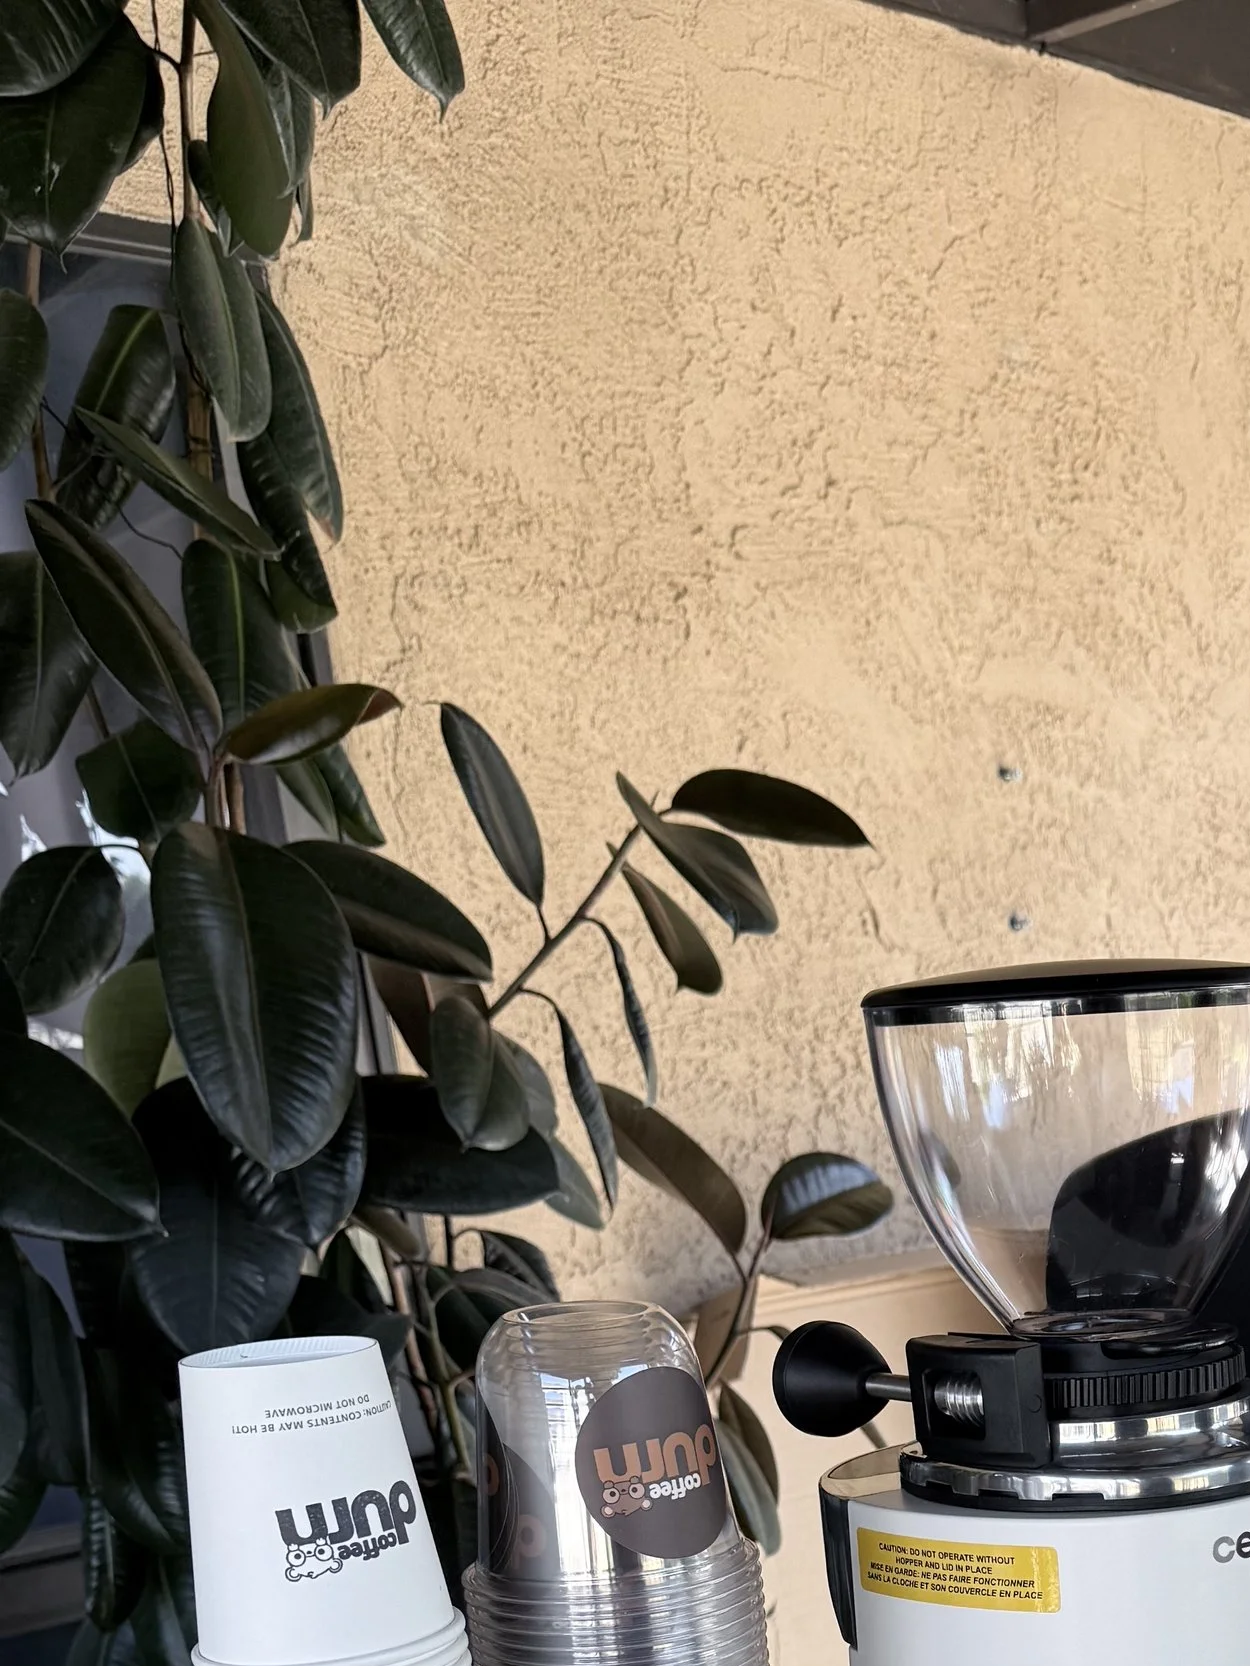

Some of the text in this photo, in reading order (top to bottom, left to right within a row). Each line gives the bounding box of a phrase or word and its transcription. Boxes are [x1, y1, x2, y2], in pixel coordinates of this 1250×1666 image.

[232, 1400, 392, 1434] CAUTION: CONTENTS MAY BE HOT!
[265, 1394, 370, 1418] DO NOT MICROWAVE
[649, 1472, 702, 1500] coffee
[337, 1532, 397, 1561] coffee
[879, 1543, 1015, 1565] CAUTION: DO NOT OPERATE WITHOUT
[871, 1561, 1035, 1588] MISE EN GARDE: NE PAS FAIRE FONCTIONNER
[896, 1556, 992, 1575] HOPPER AND LID IN PLACE
[867, 1571, 1043, 1599] SANS LA CLOCHE ET SON COUVERCLE EN PLACE
